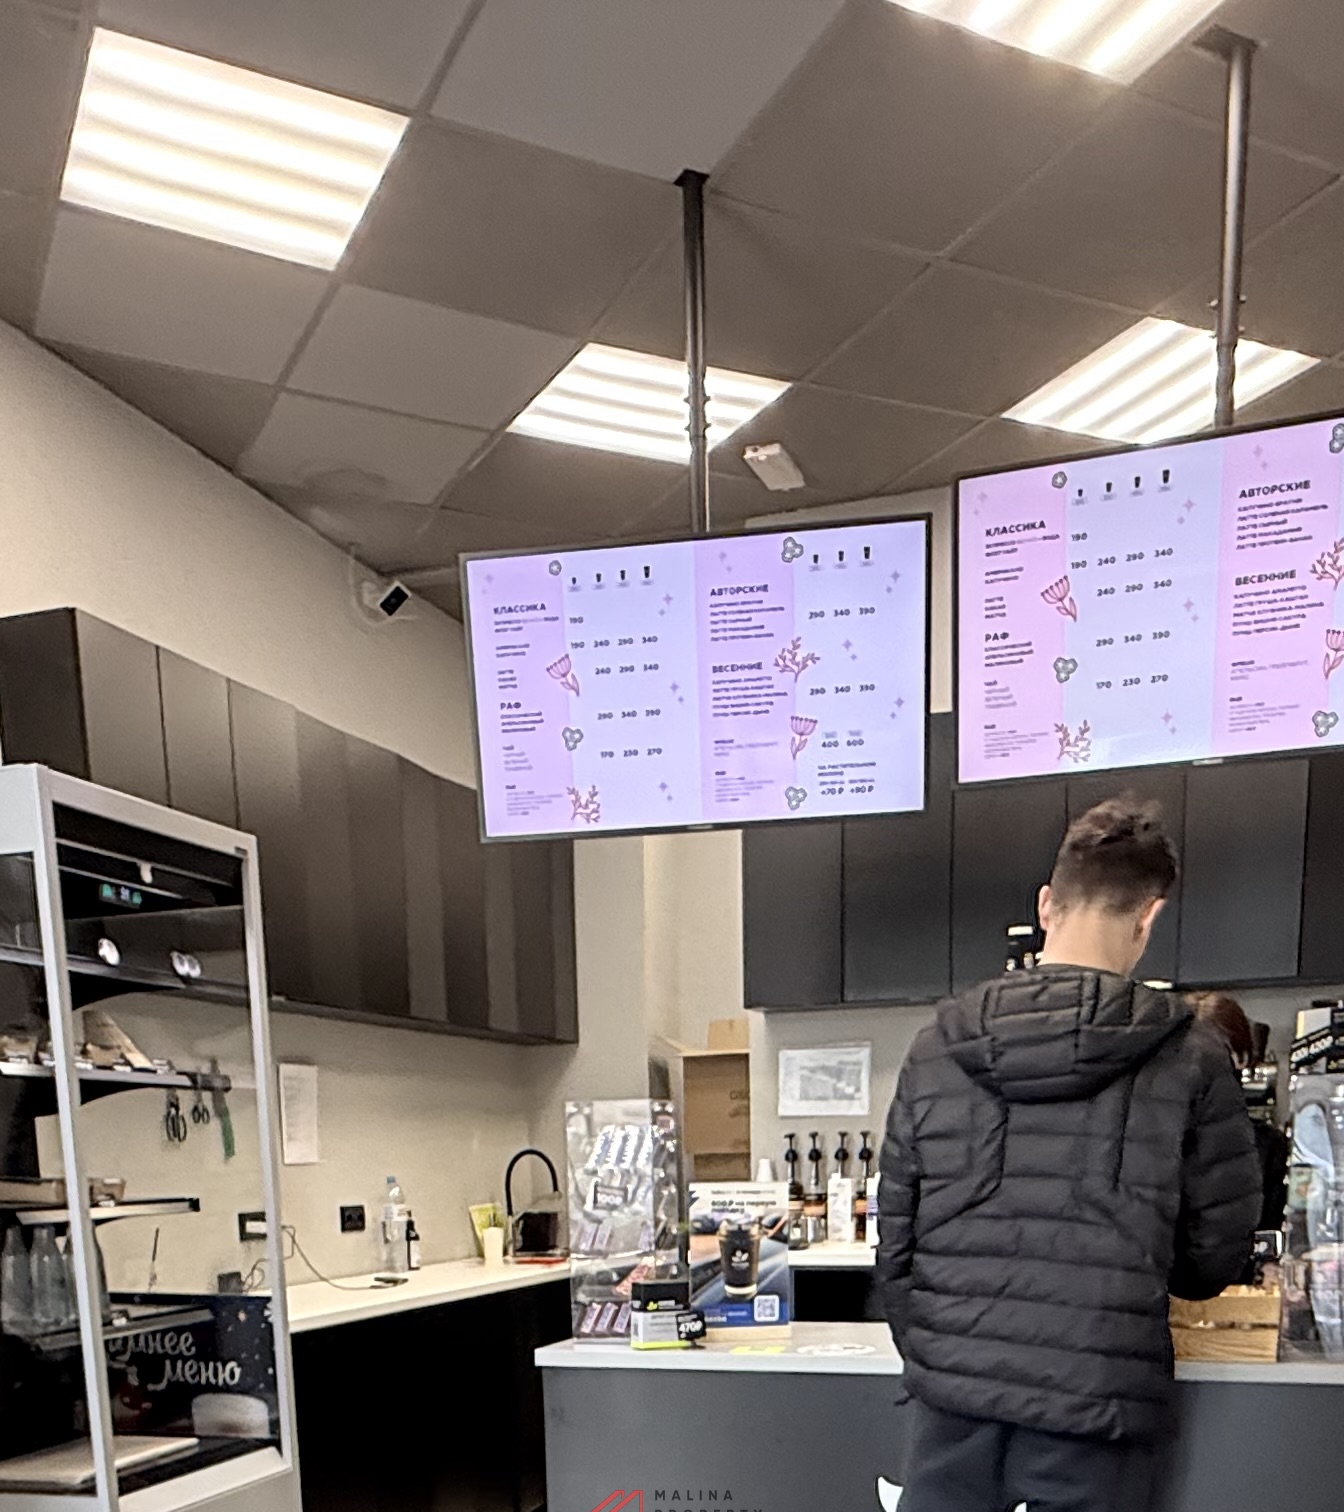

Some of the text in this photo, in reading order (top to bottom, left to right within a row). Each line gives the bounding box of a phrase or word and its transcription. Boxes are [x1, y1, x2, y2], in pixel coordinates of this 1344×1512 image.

[1239, 480, 1311, 499] АВТОРСКИЕ
[985, 520, 1046, 537] КЛАССИКА
[1071, 533, 1088, 541] 190
[1071, 548, 1174, 570] 190 240 290 340
[1235, 570, 1297, 586] ВЕСЕННИЕ
[710, 584, 769, 597] АВТОРСКИЕ
[1097, 587, 1116, 597] 240
[1125, 583, 1143, 593] 290
[494, 603, 547, 615] КЛАССИКА
[809, 611, 825, 620] 290
[859, 607, 876, 615] 390
[985, 633, 1010, 642] РАФ
[1096, 638, 1114, 647] 290
[1152, 630, 1170, 640] 390
[571, 641, 585, 649] 190
[810, 687, 826, 696] 290
[859, 684, 875, 692] 390
[1096, 681, 1112, 689] 170
[500, 702, 522, 711] РАФ
[679, 1320, 703, 1333] 470₽
[147, 1359, 242, 1391] меню
